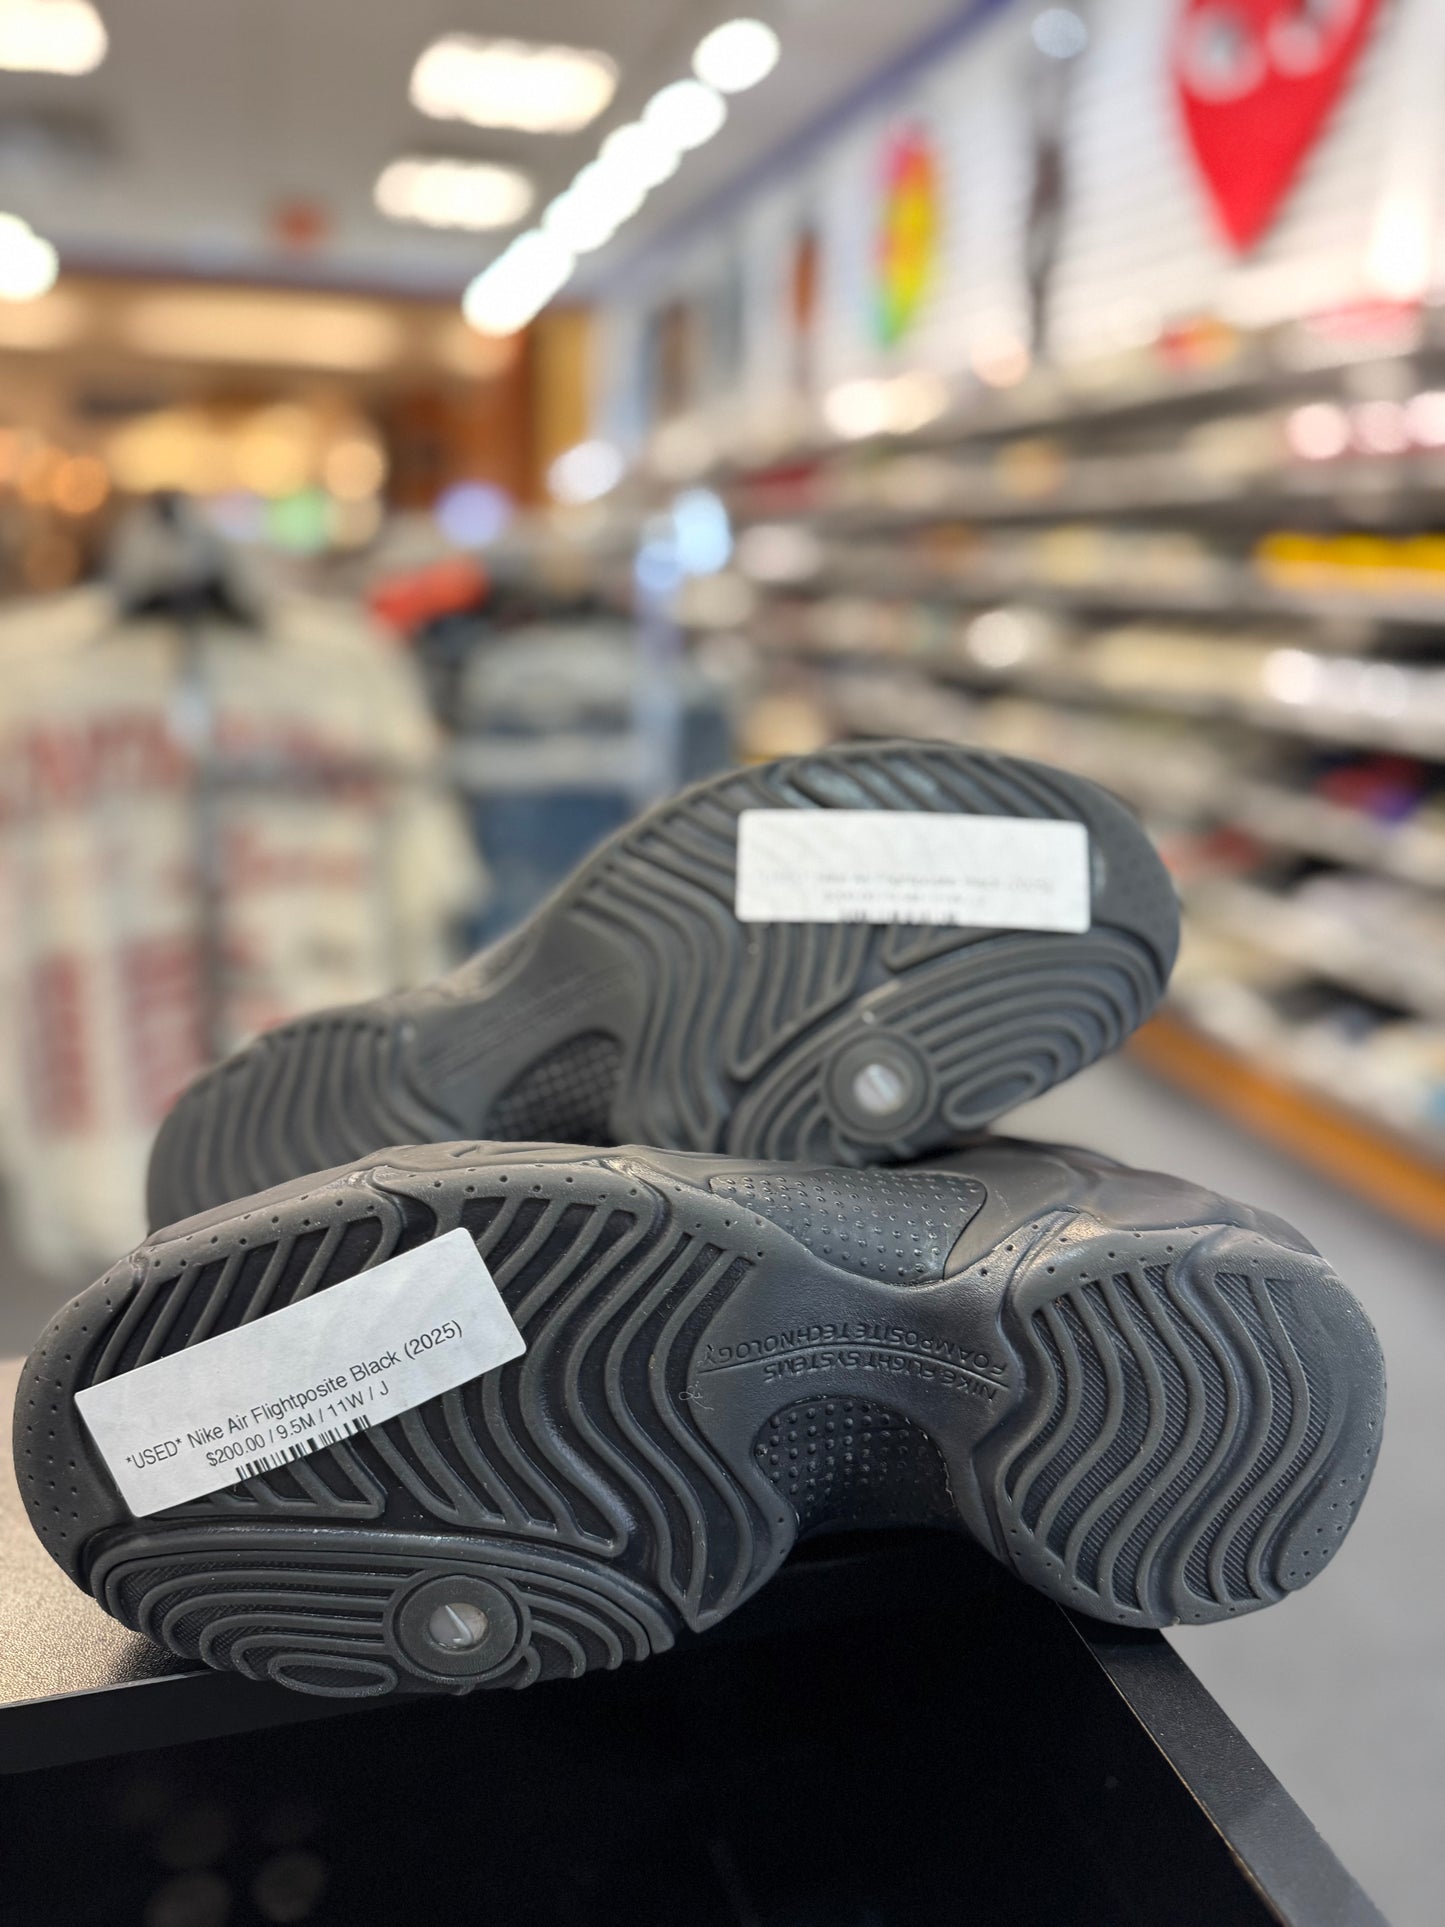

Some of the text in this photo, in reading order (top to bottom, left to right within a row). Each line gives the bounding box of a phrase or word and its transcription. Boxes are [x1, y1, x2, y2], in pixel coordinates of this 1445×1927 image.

[702, 1323, 850, 1366] TECHNOLOGY
[763, 1351, 860, 1383] SYSTEMS
[187, 1426, 224, 1448] Nike
[228, 1415, 249, 1434] Air
[251, 1376, 348, 1424] Flightposite
[350, 1351, 402, 1382] Black
[404, 1319, 463, 1361] (2025)
[205, 1434, 266, 1468] $200.00
[276, 1413, 317, 1440] 9.5M
[327, 1391, 364, 1417] 11W
[379, 1381, 389, 1396] J
